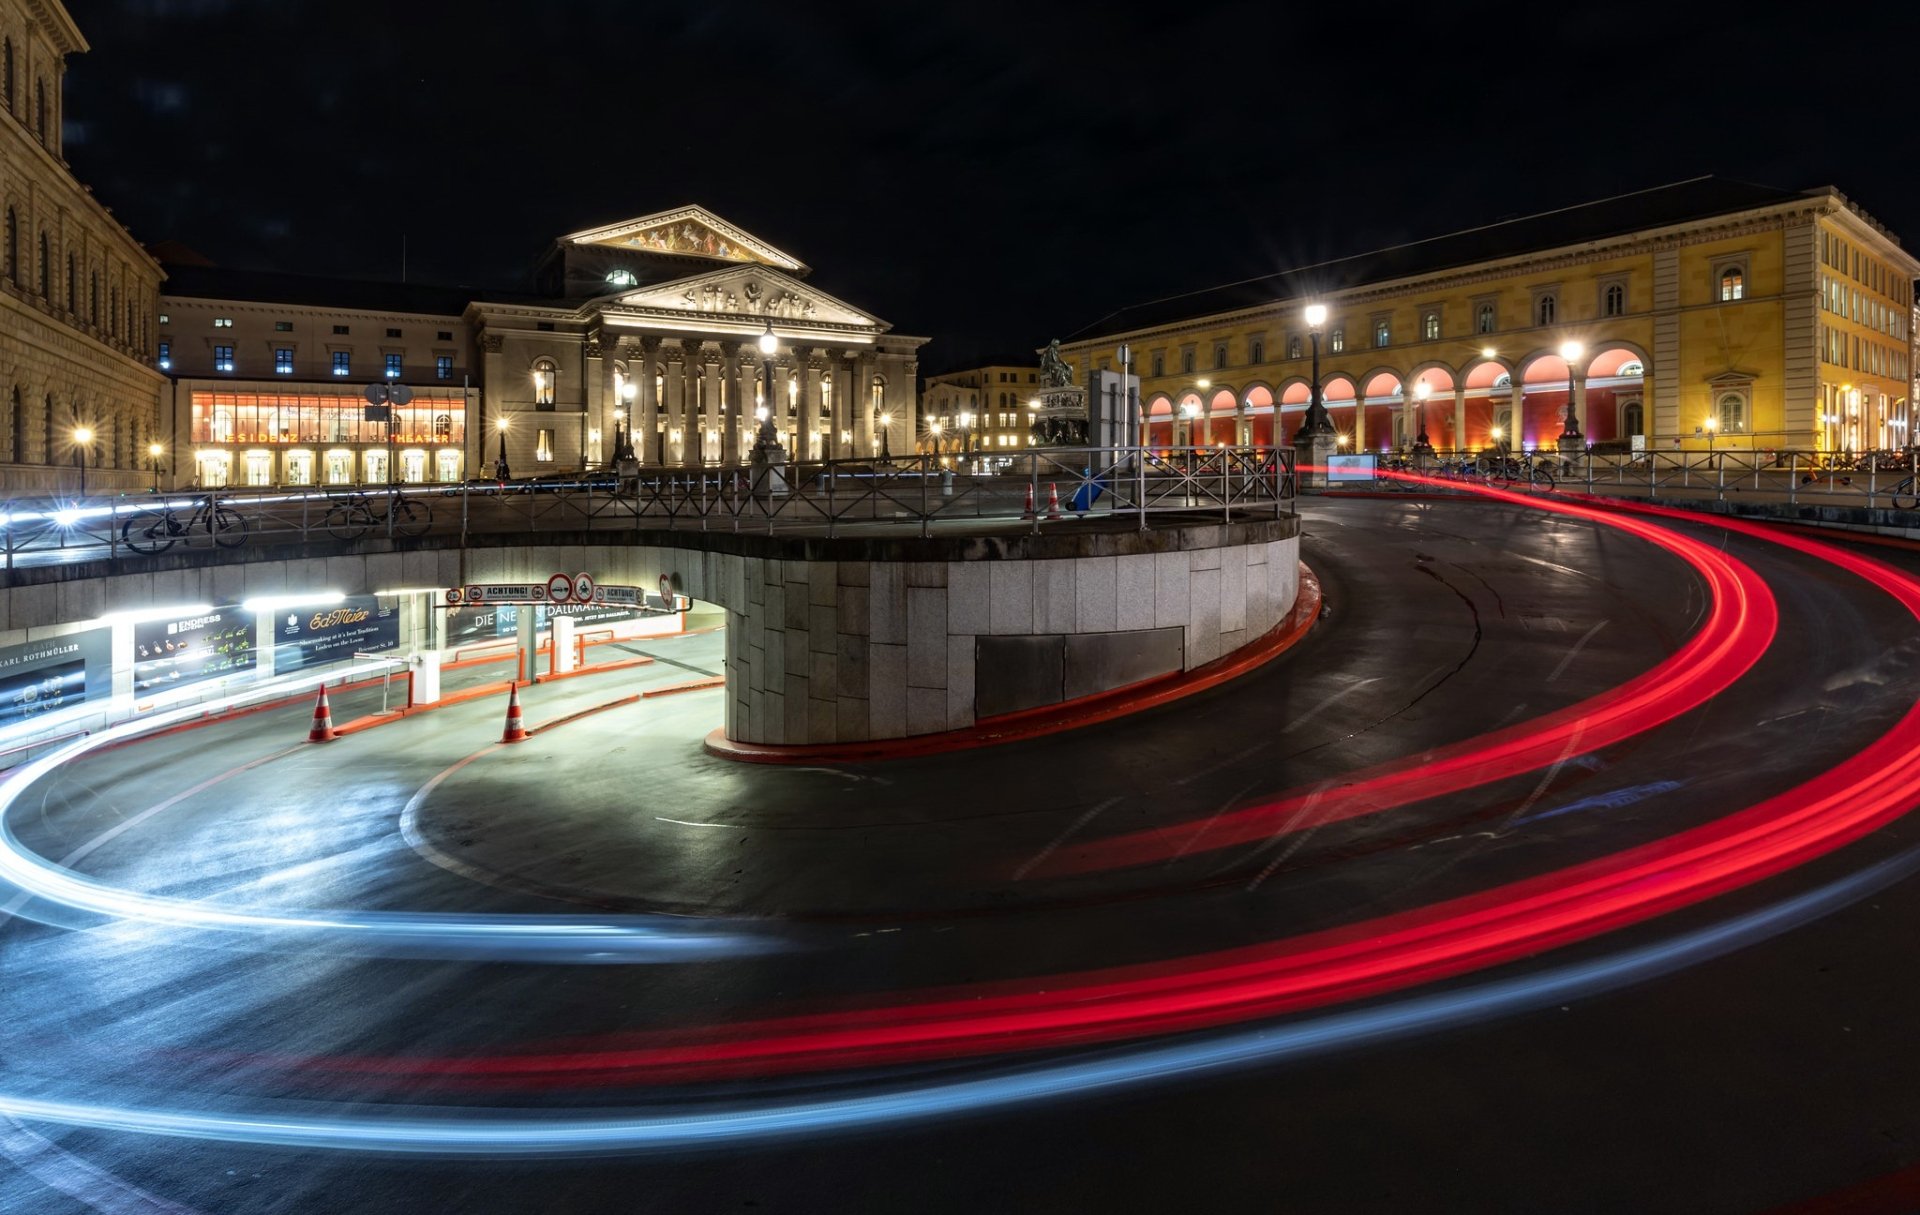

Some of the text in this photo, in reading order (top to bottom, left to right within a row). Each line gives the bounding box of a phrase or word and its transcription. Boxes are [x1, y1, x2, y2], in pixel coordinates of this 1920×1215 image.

[486, 586, 528, 595] ACHTUNG!
[178, 614, 221, 627] ENDRESS
[475, 613, 494, 627] DIE
[23, 643, 80, 663] ROTHMÜLLER
